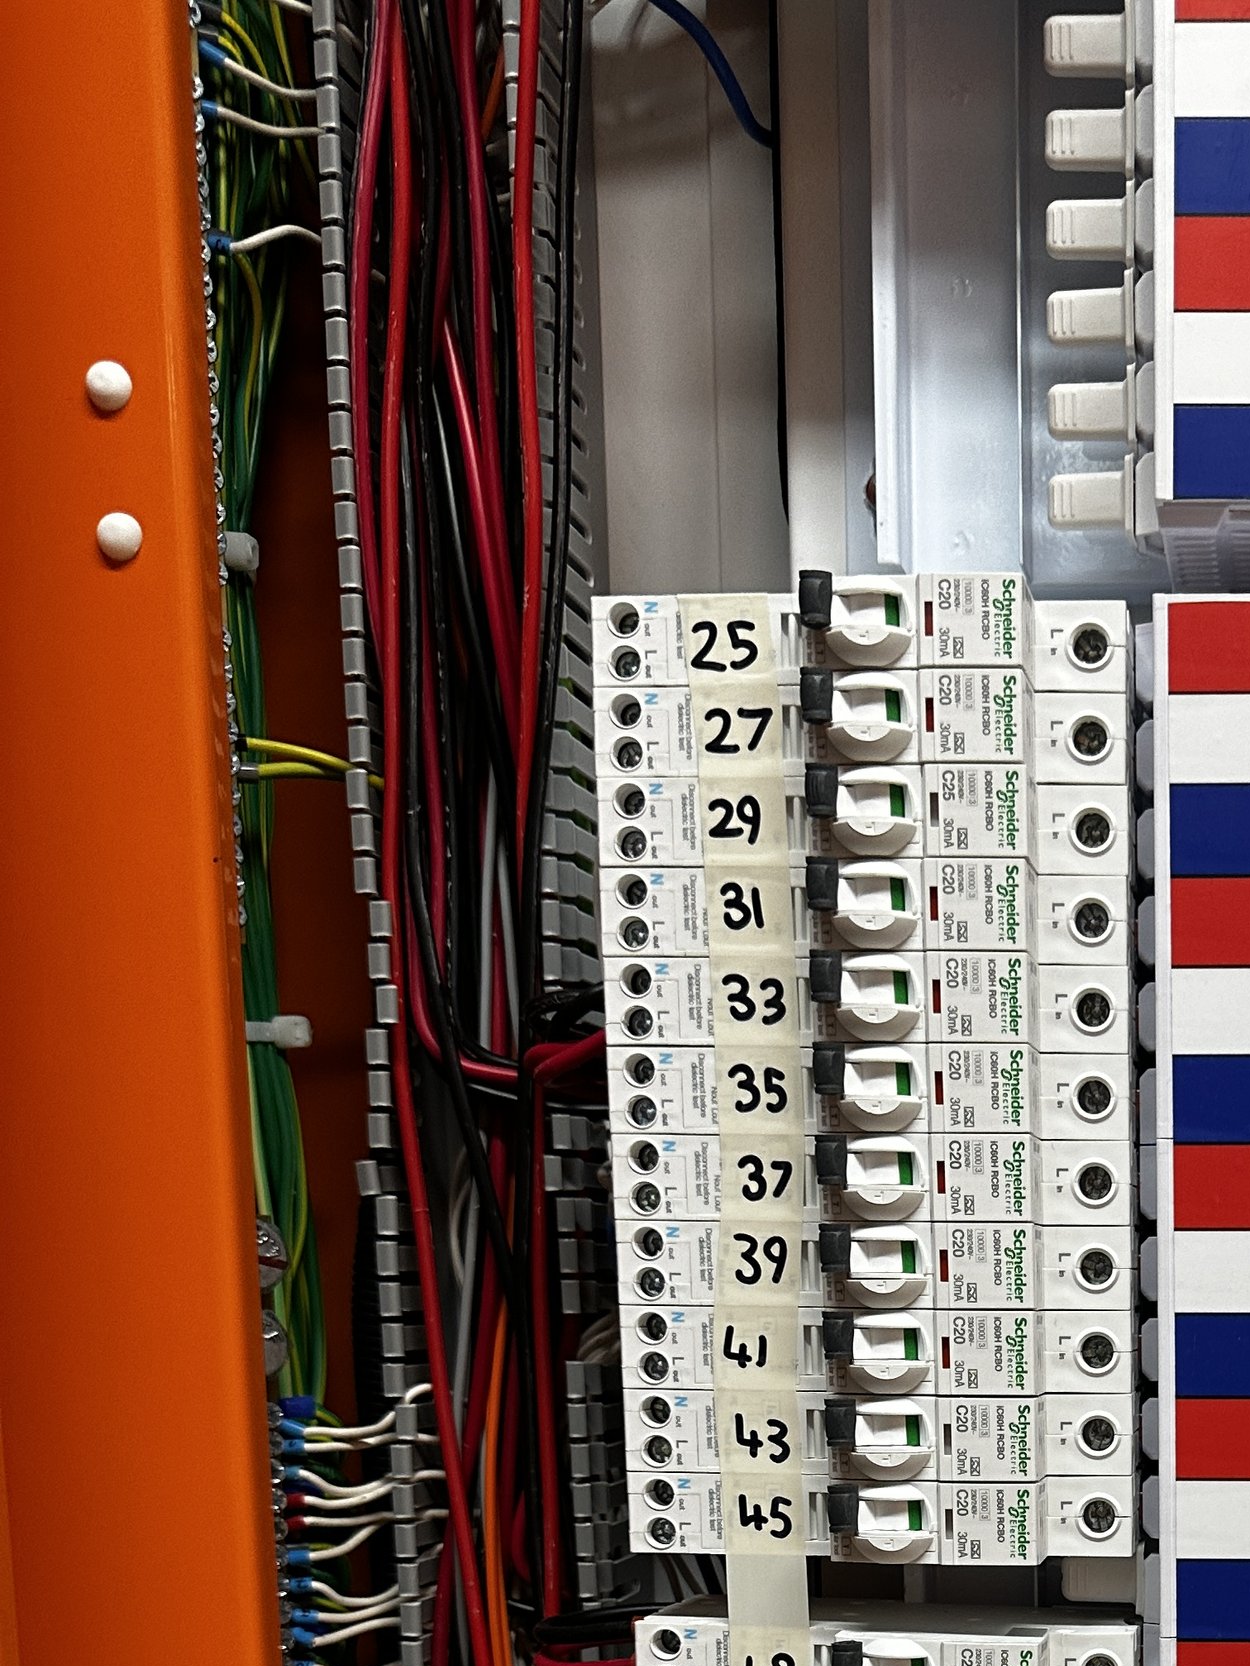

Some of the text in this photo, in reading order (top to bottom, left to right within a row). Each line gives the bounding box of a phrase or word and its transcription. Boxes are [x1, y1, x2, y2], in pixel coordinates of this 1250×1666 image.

[938, 579, 951, 657] C20 30mA
[1003, 579, 1016, 659] Schneider
[691, 620, 758, 672] 25
[939, 675, 952, 705] C20
[705, 708, 773, 753] 27
[1004, 676, 1017, 755] Schneider
[649, 784, 663, 795] N
[942, 770, 955, 801] C25
[1006, 771, 1019, 850] Schneider
[651, 832, 663, 842] L
[708, 795, 761, 845] 29
[942, 864, 955, 895] C20
[1006, 865, 1019, 944] Schneider
[720, 882, 764, 930] 31
[946, 958, 959, 988] C20
[1009, 959, 1022, 1035] Schneider
[722, 974, 786, 1025] 33
[728, 1064, 787, 1113] 35
[949, 1051, 961, 1080] C20
[1010, 1050, 1024, 1126] Schneider
[738, 1155, 792, 1201] 37
[949, 1140, 962, 1169] C20
[1013, 1141, 1026, 1216] Schneider
[733, 1233, 787, 1285] 39
[952, 1229, 965, 1302] C20 30mA
[1014, 1230, 1026, 1303] Schneider
[723, 1325, 767, 1368] 41
[953, 1317, 965, 1344] C20
[1015, 1318, 1028, 1390] Schneider
[735, 1413, 790, 1463] 43
[956, 1405, 968, 1432] C20
[1018, 1405, 1031, 1476] Schneider
[739, 1494, 792, 1538] 45
[957, 1489, 968, 1516] C20
[1017, 1490, 1030, 1560] Schneider
